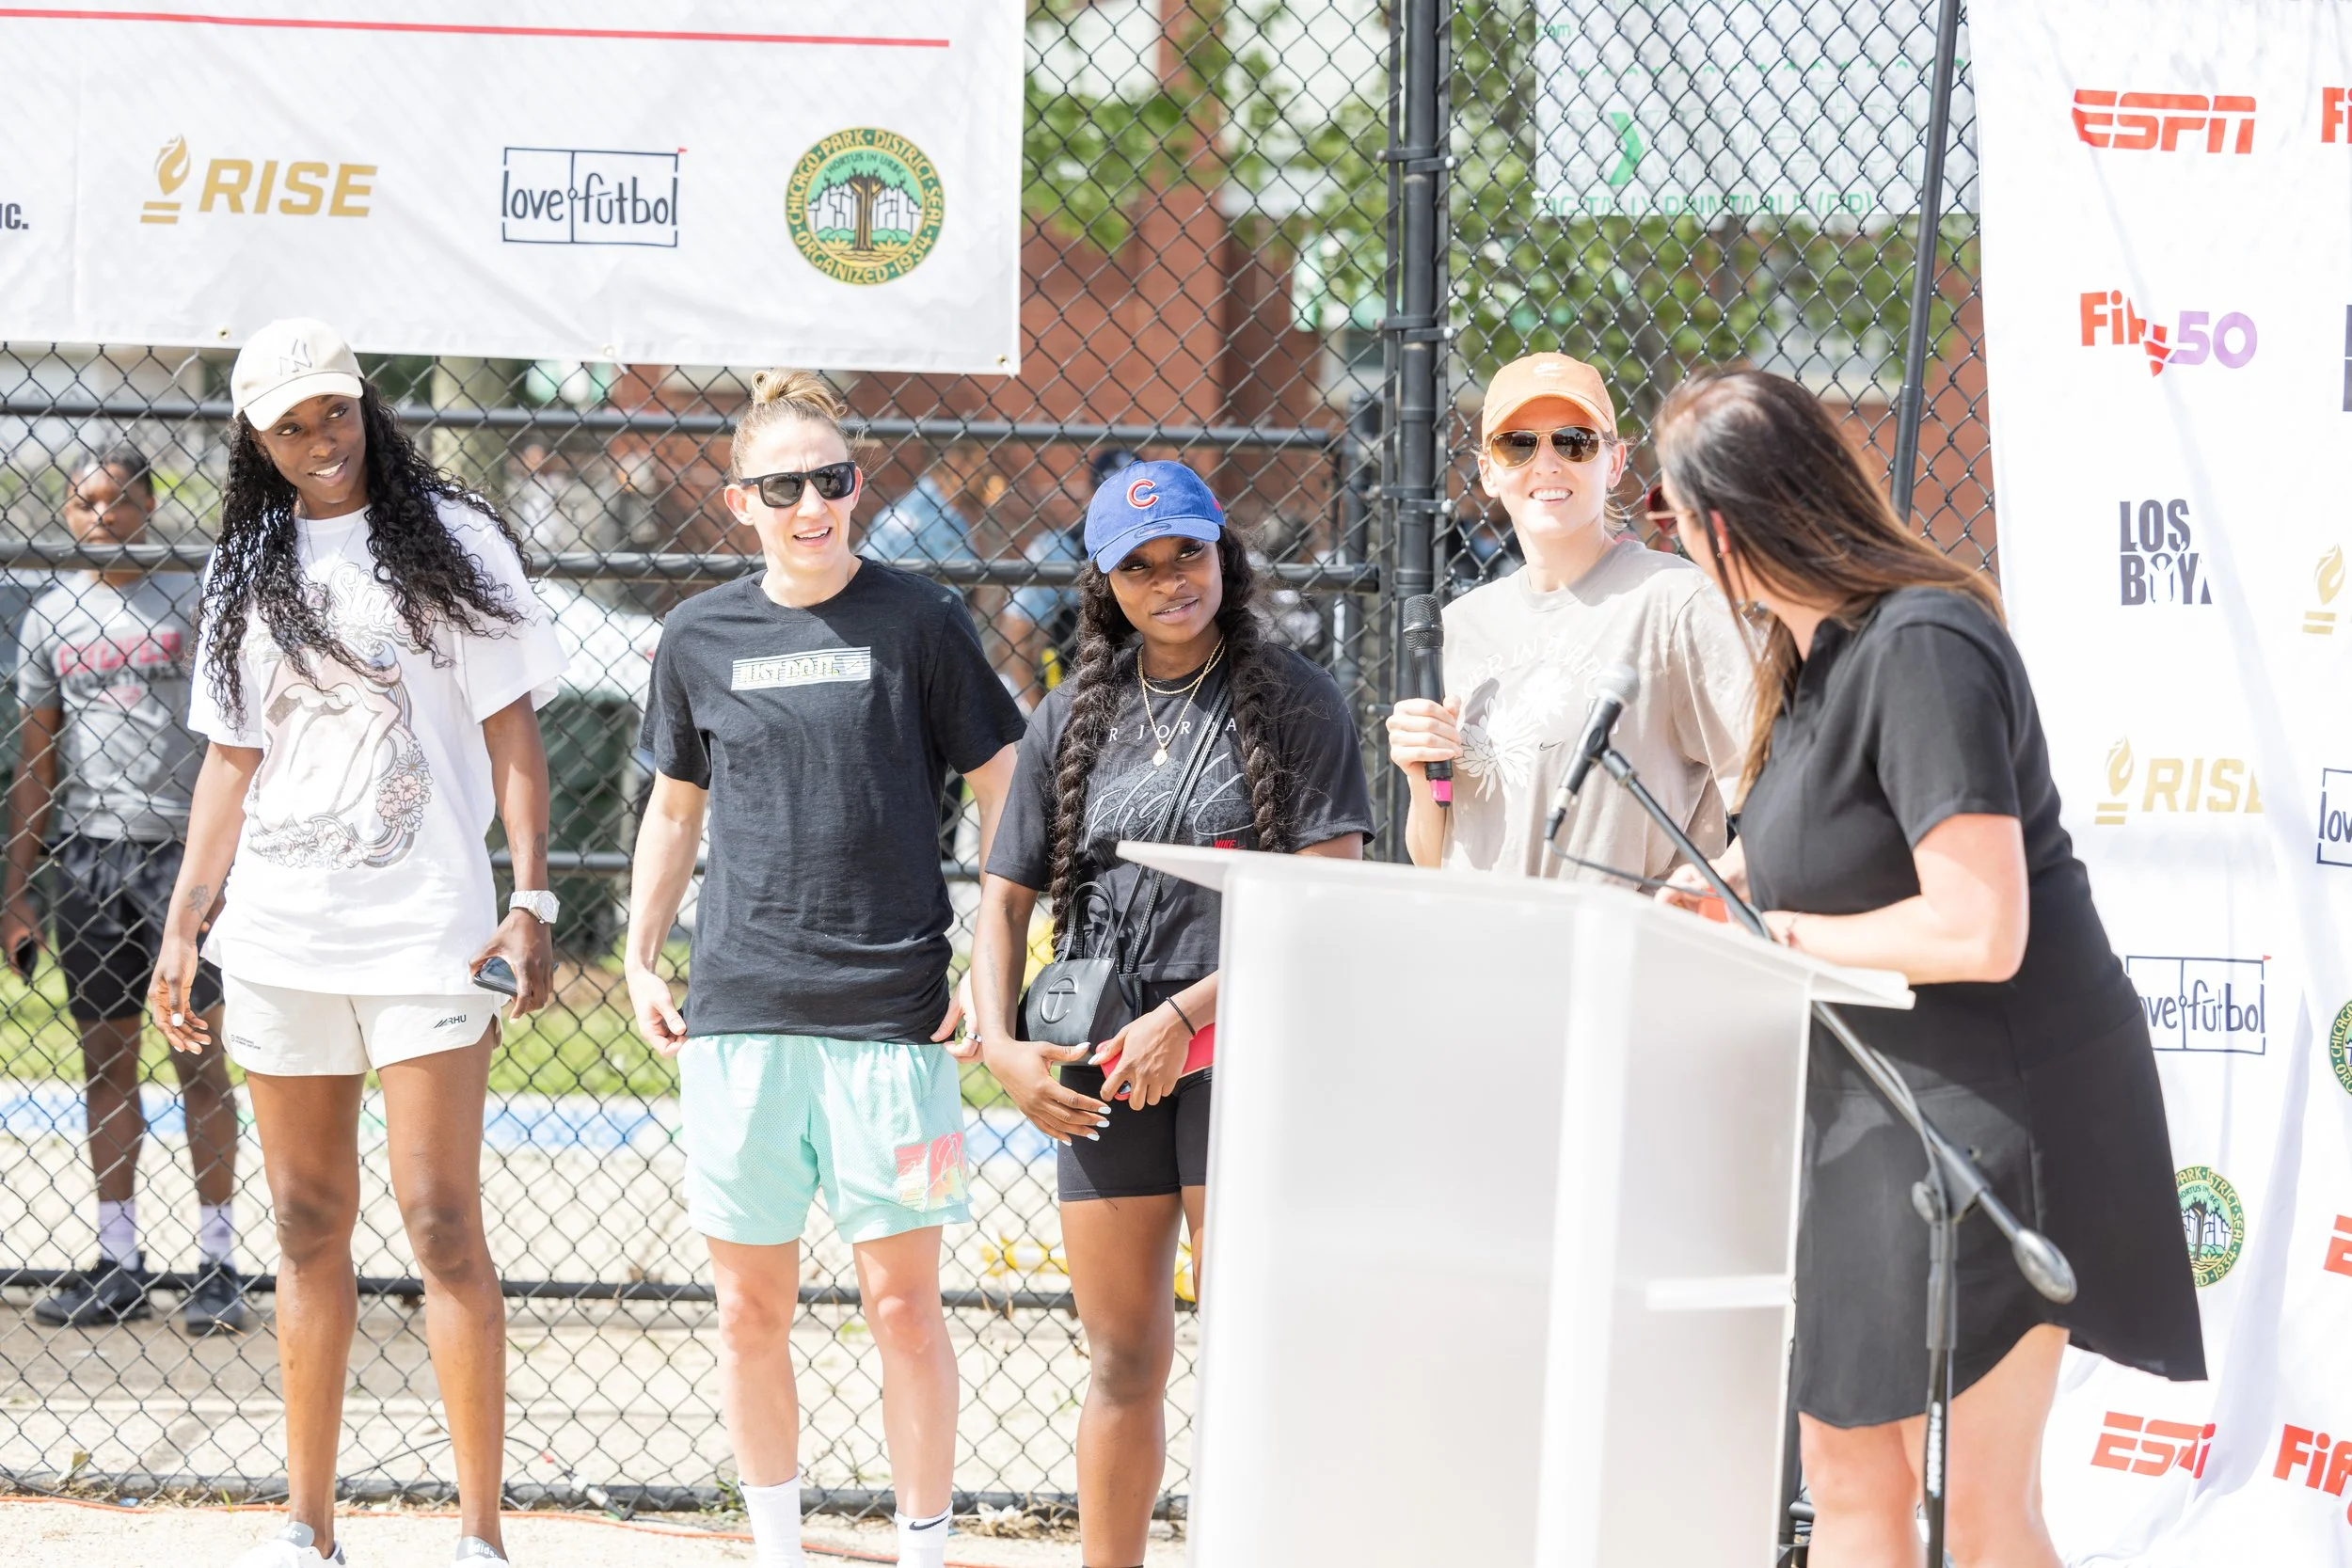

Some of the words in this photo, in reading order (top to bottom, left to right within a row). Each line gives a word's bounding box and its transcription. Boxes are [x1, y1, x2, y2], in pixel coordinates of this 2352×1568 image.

[2072, 89, 2256, 154] ESPN
[199, 158, 378, 218] RISE
[787, 152, 819, 226] CHICAGO
[819, 129, 867, 155] PARK
[873, 130, 935, 183] DISTRICT
[924, 185, 943, 229] SEAL
[825, 152, 865, 175] HORTUS
[866, 152, 878, 163] IN
[502, 170, 564, 222] love
[794, 230, 889, 283] ORGANIZED
[893, 234, 933, 276] 1934
[1127, 478, 1159, 509] C
[2232, 1212, 2244, 1246] SEAL
[2213, 1250, 2238, 1280] 1934
